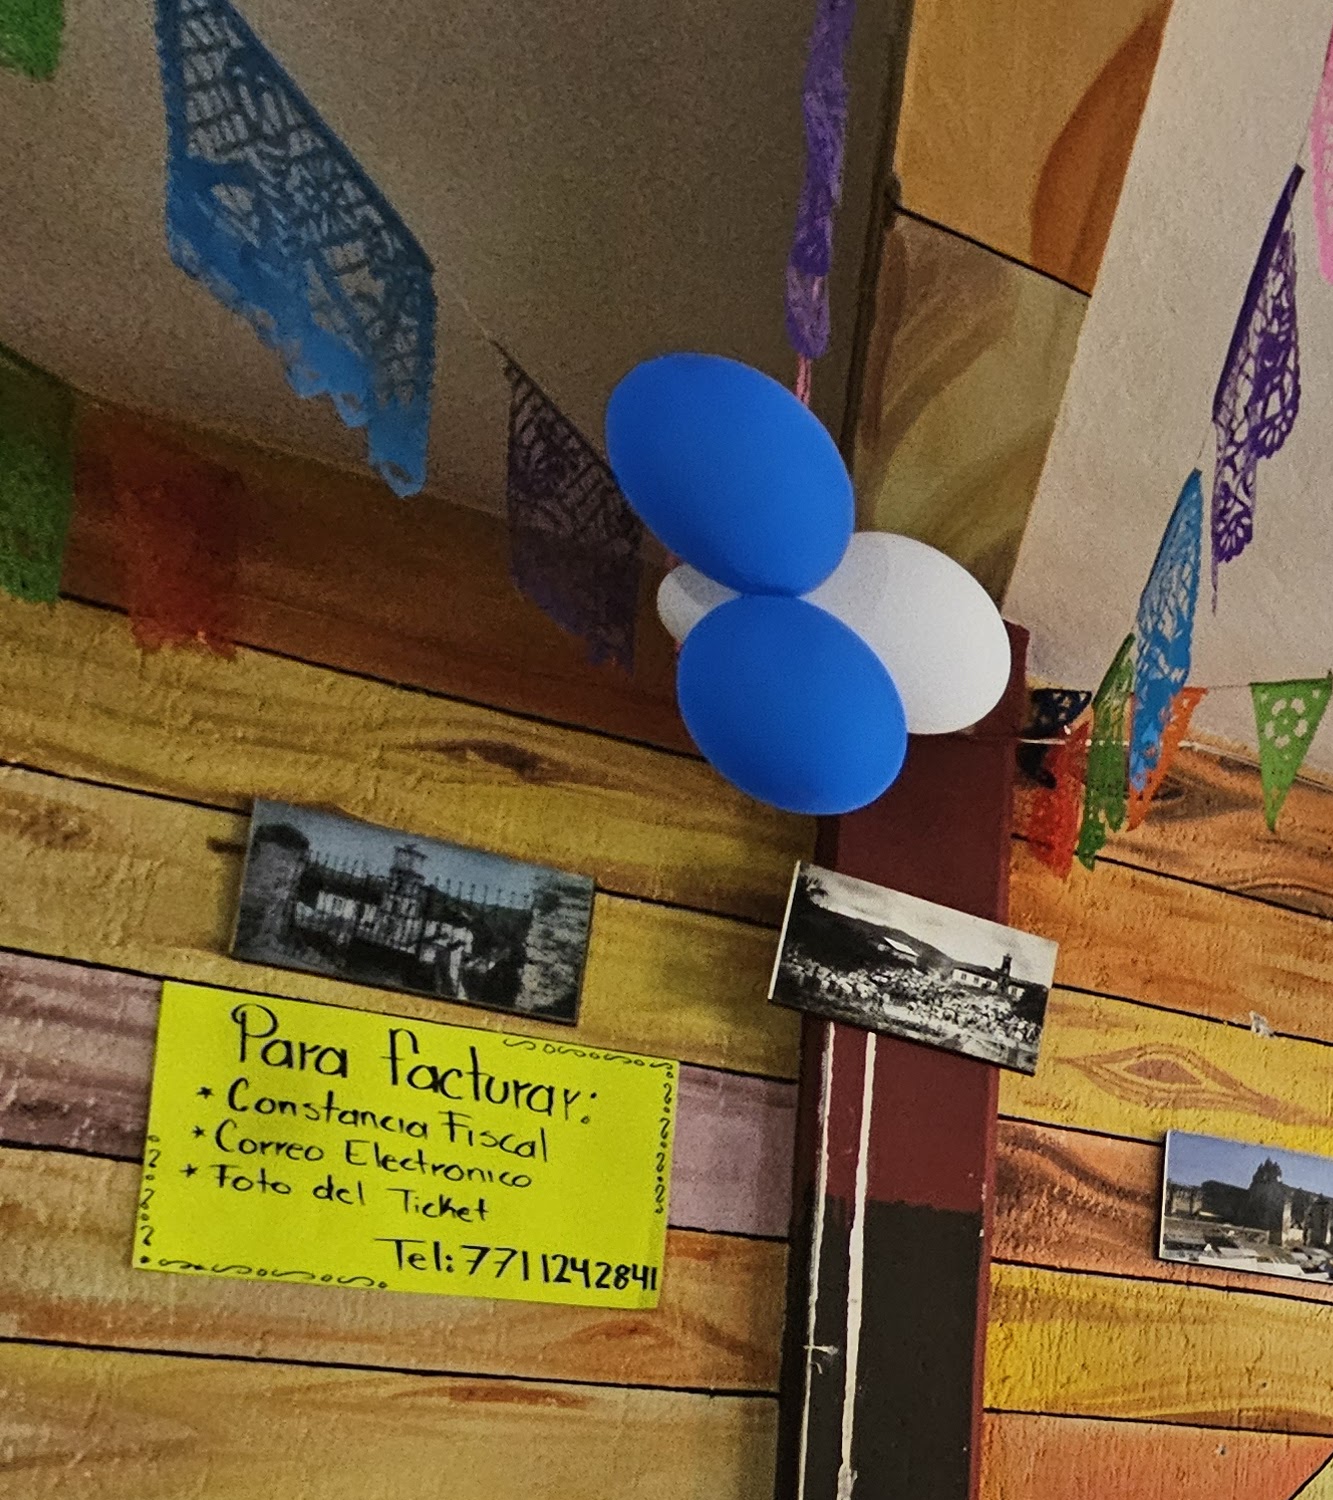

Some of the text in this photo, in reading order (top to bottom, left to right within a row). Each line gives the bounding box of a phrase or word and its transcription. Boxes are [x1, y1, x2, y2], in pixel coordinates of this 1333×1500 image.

[231, 1003, 598, 1124] Para facturar:
[215, 1118, 532, 1188] Correo Electronico
[227, 1077, 548, 1163] Constancia Fiscal
[209, 1163, 489, 1223] Foto del Ticket
